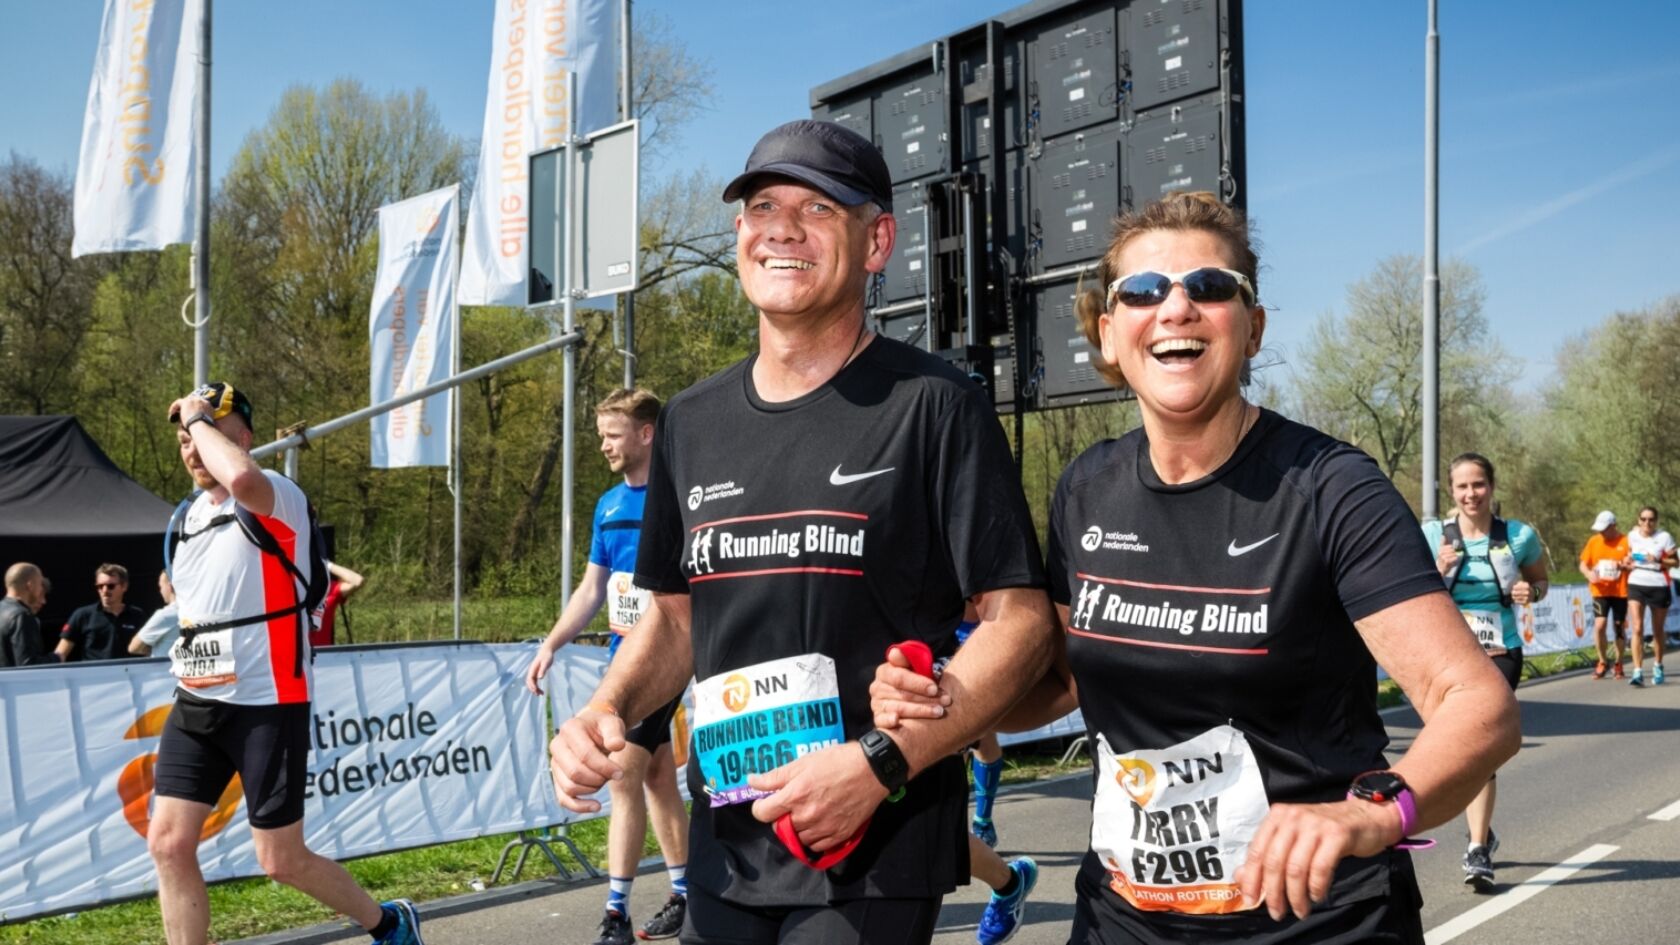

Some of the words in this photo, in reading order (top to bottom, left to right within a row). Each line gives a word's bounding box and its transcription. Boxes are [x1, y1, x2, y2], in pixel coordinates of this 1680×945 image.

[719, 528, 801, 559] Running
[804, 524, 865, 556] Blind
[1102, 541, 1149, 552] nederlanden
[1104, 531, 1138, 542] nationale
[1102, 593, 1198, 635] Running
[1200, 603, 1269, 634] Blind
[754, 674, 789, 696] NN
[309, 702, 437, 750] tionale
[698, 713, 769, 753] RUNNING
[772, 701, 839, 735] BLIND
[717, 739, 796, 785] 19466
[1162, 752, 1224, 787] NN
[1130, 796, 1220, 847] TERRY
[1131, 846, 1224, 884] F296
